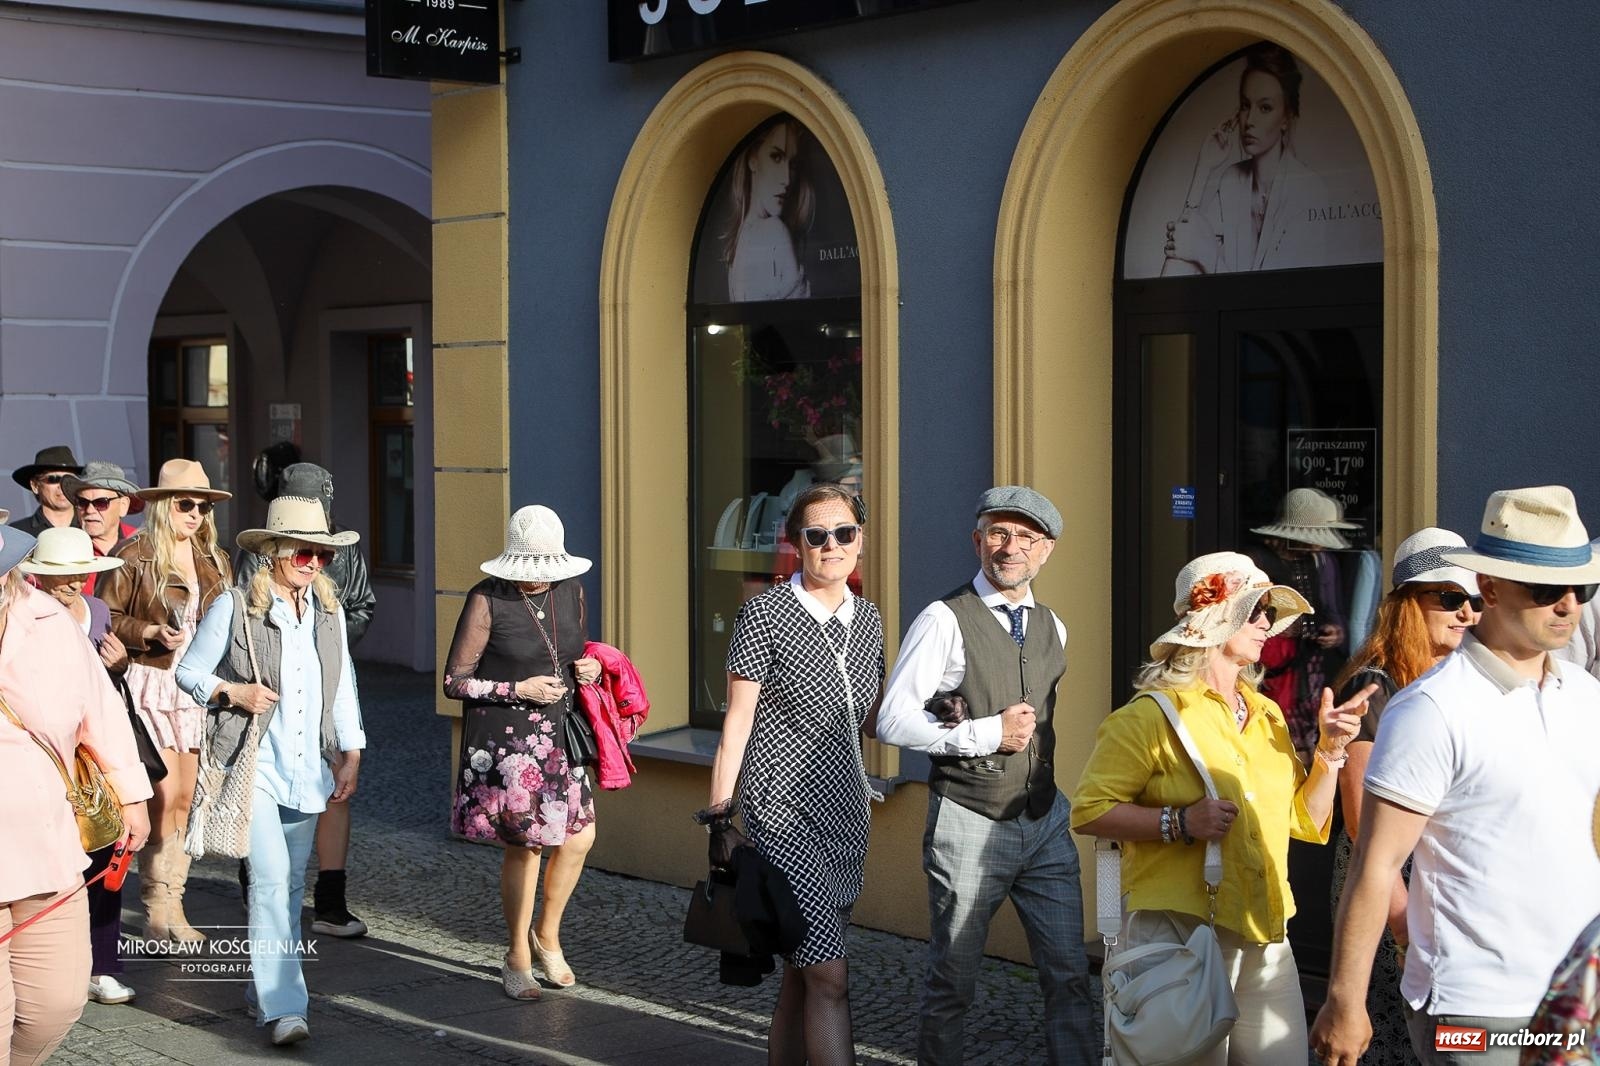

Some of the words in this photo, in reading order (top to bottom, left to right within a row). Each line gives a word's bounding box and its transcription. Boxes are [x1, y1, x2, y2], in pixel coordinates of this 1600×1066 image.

[426, 0, 455, 9] 1989
[391, 25, 421, 45] M.
[426, 27, 488, 55] Karpisz
[1296, 437, 1368, 452] Zapraszamy
[1315, 477, 1346, 490] soboty
